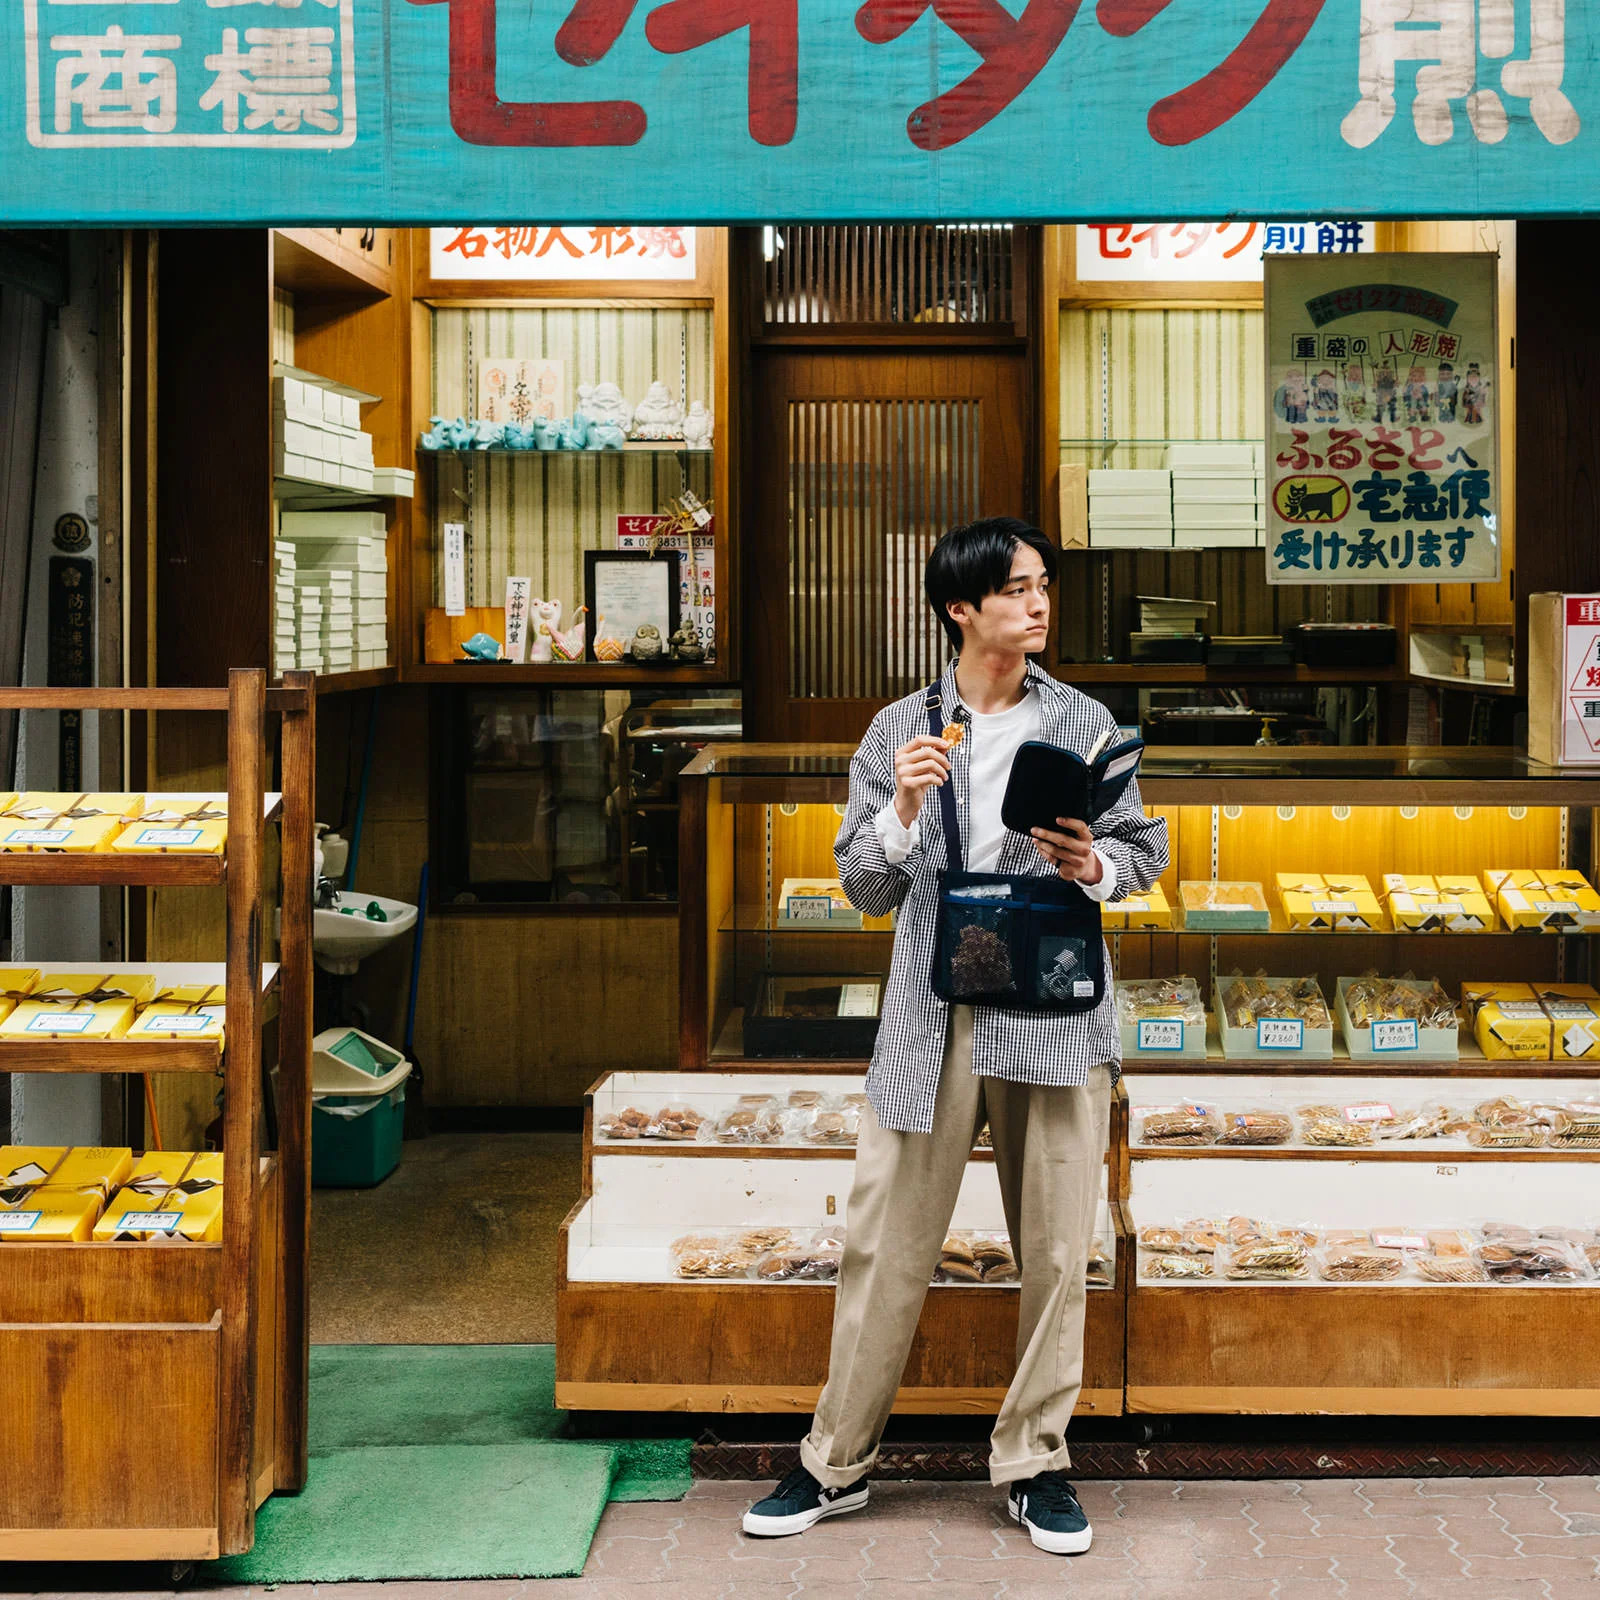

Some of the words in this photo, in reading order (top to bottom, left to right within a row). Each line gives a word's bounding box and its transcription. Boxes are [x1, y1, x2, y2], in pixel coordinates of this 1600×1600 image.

[50, 24, 339, 133] 商標
[1276, 426, 1479, 471] ふるさとへ
[1352, 469, 1492, 523] 宅急便
[1273, 526, 1475, 570] 受け承ります
